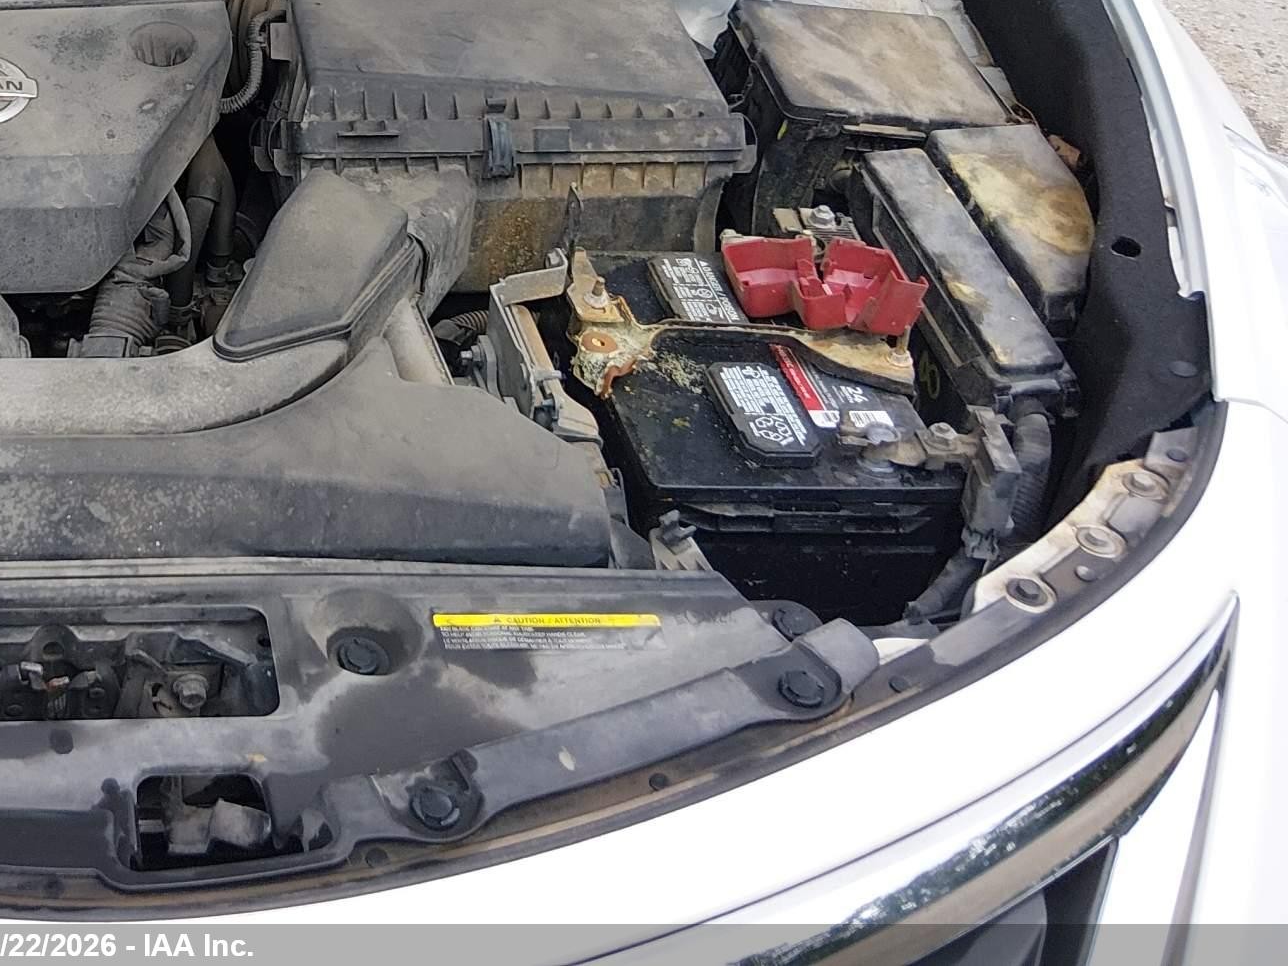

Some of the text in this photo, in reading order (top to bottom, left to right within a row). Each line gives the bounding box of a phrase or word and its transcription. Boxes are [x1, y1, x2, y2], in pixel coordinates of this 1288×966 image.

[719, 296, 740, 321] POISON
[847, 386, 869, 403] 24
[507, 616, 545, 625] CAUTION
[554, 616, 601, 625] ATTENTION
